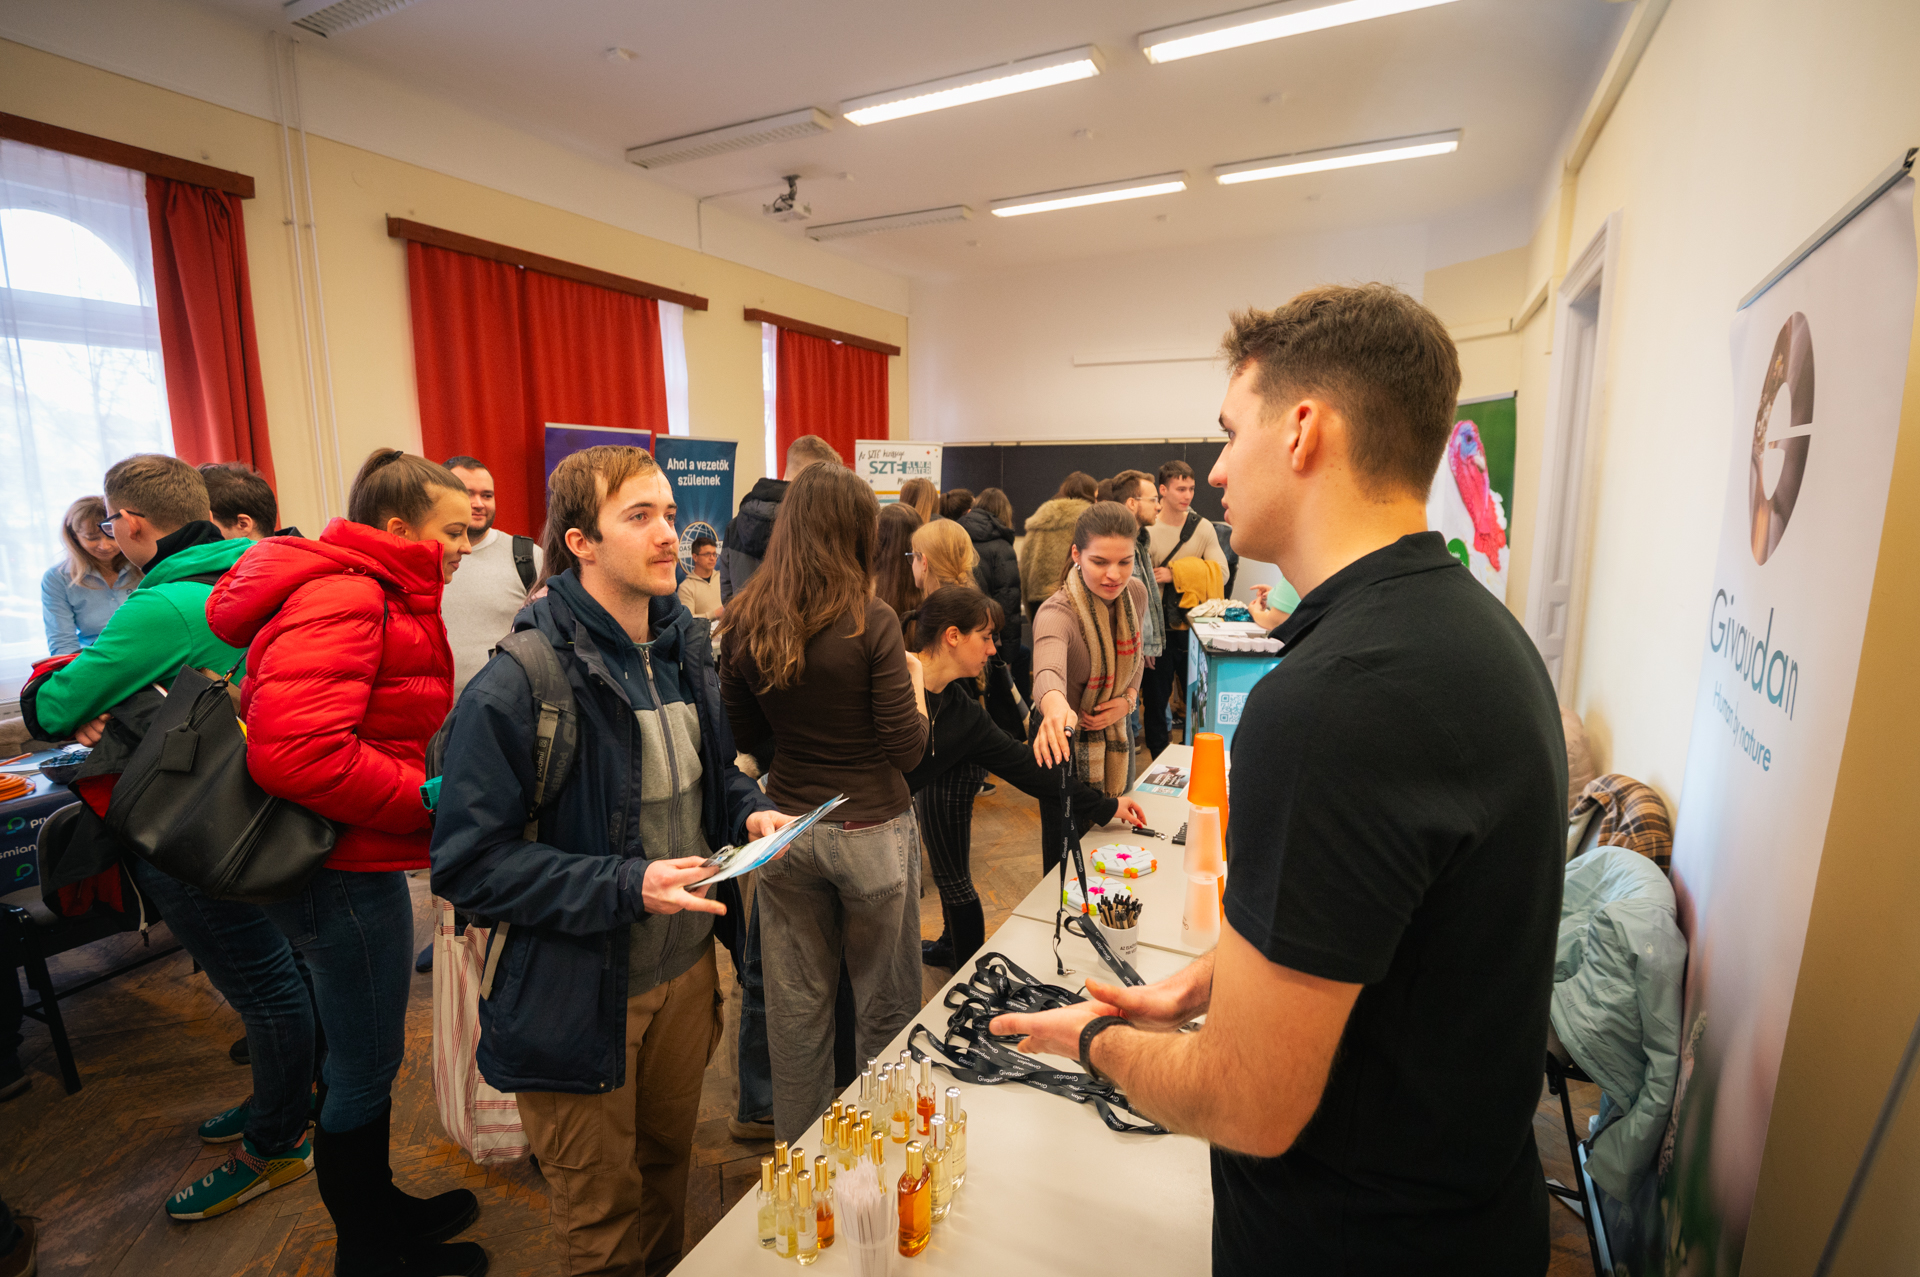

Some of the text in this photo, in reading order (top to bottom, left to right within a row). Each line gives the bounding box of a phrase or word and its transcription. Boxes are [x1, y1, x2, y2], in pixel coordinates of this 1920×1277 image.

[667, 458, 729, 471] Ahol a vezetők
[678, 474, 720, 486] születnek
[1710, 588, 1799, 721] Givaudan
[1713, 680, 1772, 772] Human by nature
[977, 1036, 999, 1054] Givaudan
[1053, 1074, 1079, 1082] Givaudan
